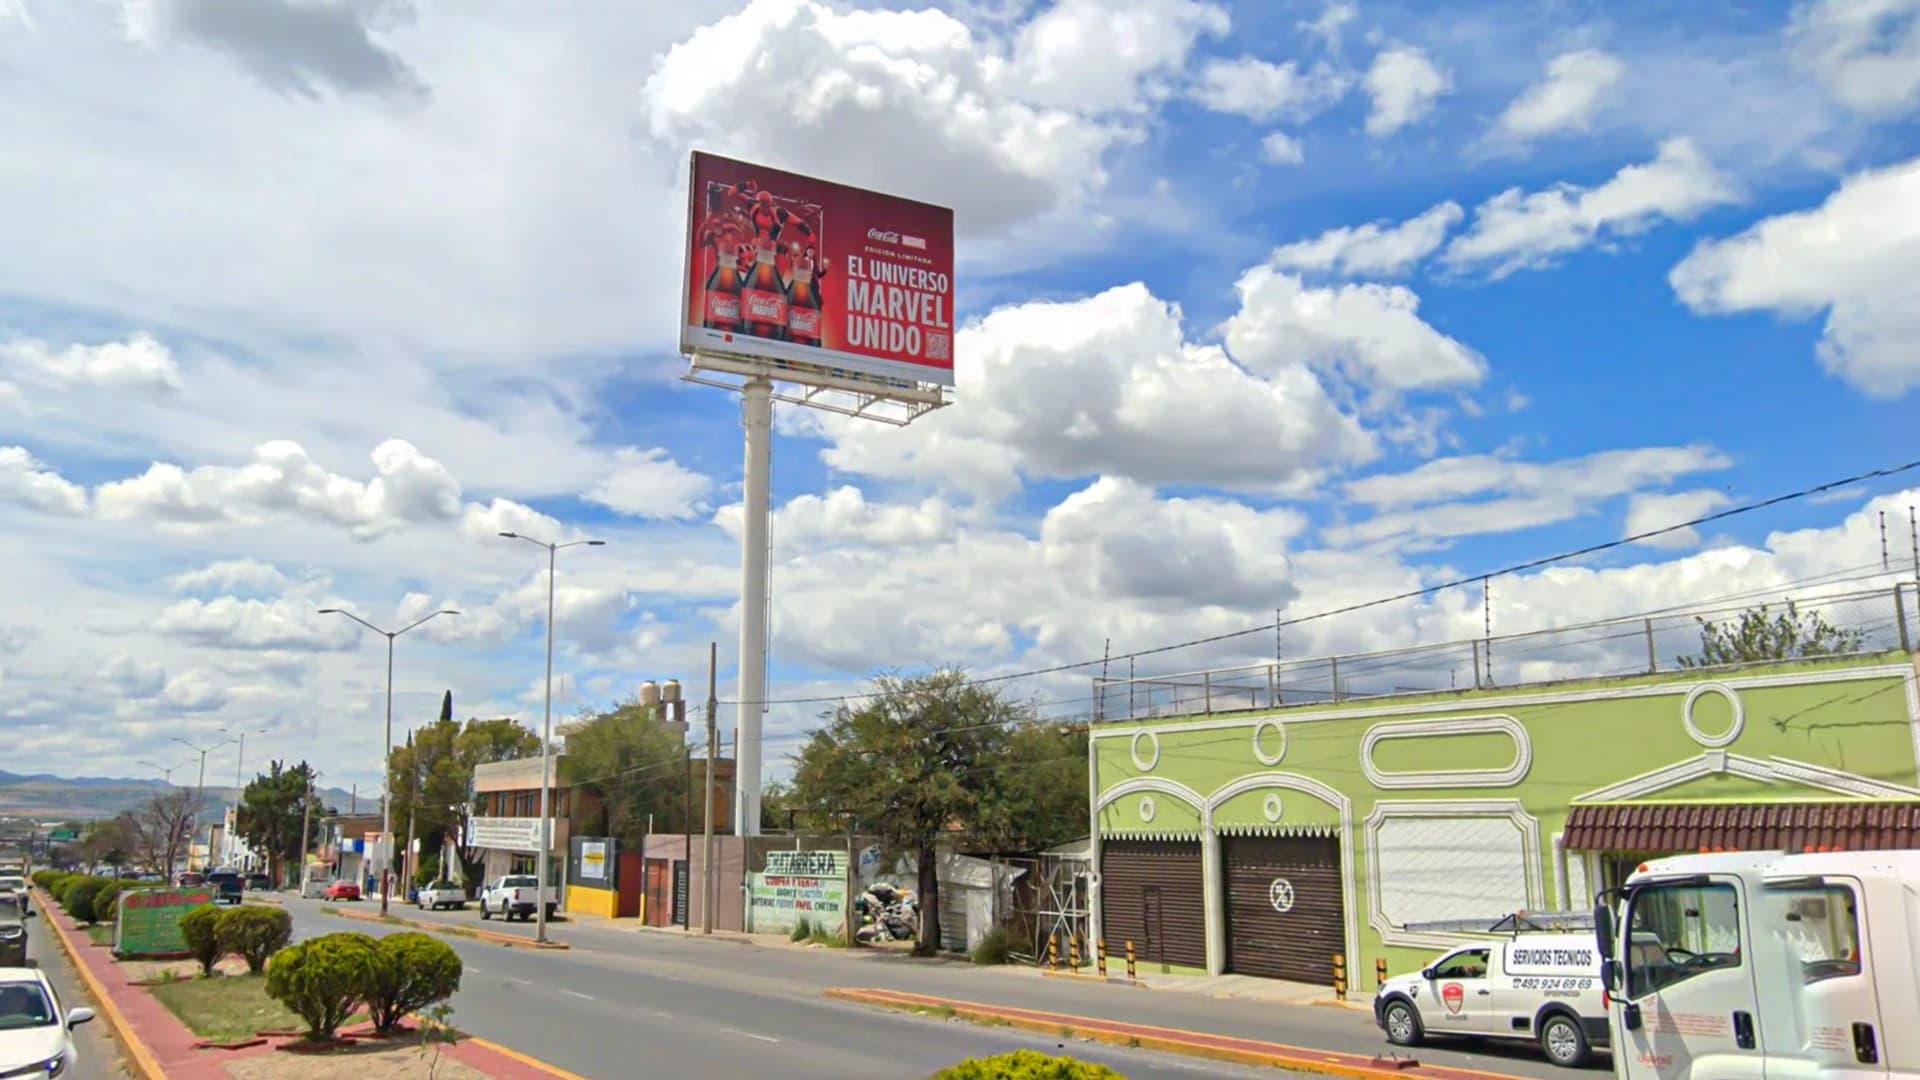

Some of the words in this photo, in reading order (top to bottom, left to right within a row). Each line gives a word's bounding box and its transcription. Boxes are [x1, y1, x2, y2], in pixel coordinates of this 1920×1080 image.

[847, 254, 867, 278] EL
[869, 259, 948, 294] UNIVERSO
[847, 278, 949, 328] MARVEL
[847, 314, 920, 356] UNIDO
[795, 899, 813, 911] PAPEL
[1513, 949, 1552, 966] SERVICIOS
[1553, 949, 1592, 966] TECNICOS
[1521, 978, 1540, 989] 492
[1541, 979, 1561, 989] 924
[1562, 979, 1577, 989] 69
[1578, 979, 1593, 990] 69
